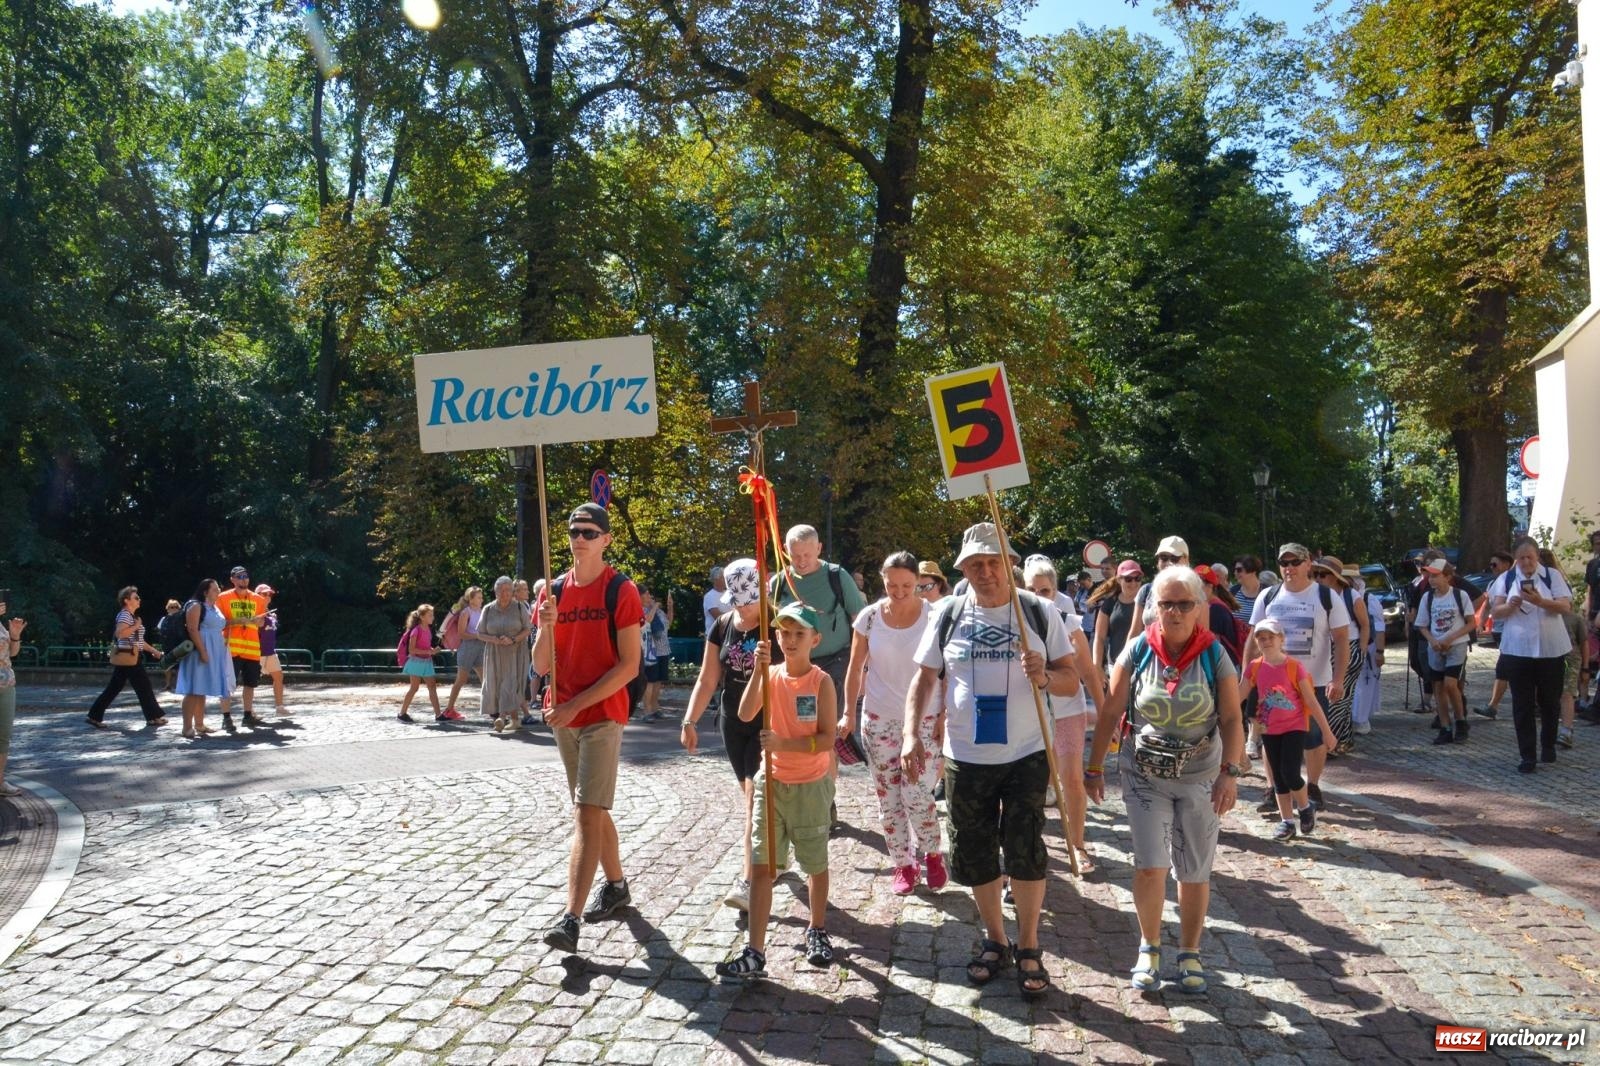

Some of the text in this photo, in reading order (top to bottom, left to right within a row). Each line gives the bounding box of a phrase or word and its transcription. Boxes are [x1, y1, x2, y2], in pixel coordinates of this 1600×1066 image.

[426, 364, 650, 426] Racibórz
[941, 379, 1004, 463] 5
[557, 605, 608, 624] addas
[970, 648, 1015, 659] umbro
